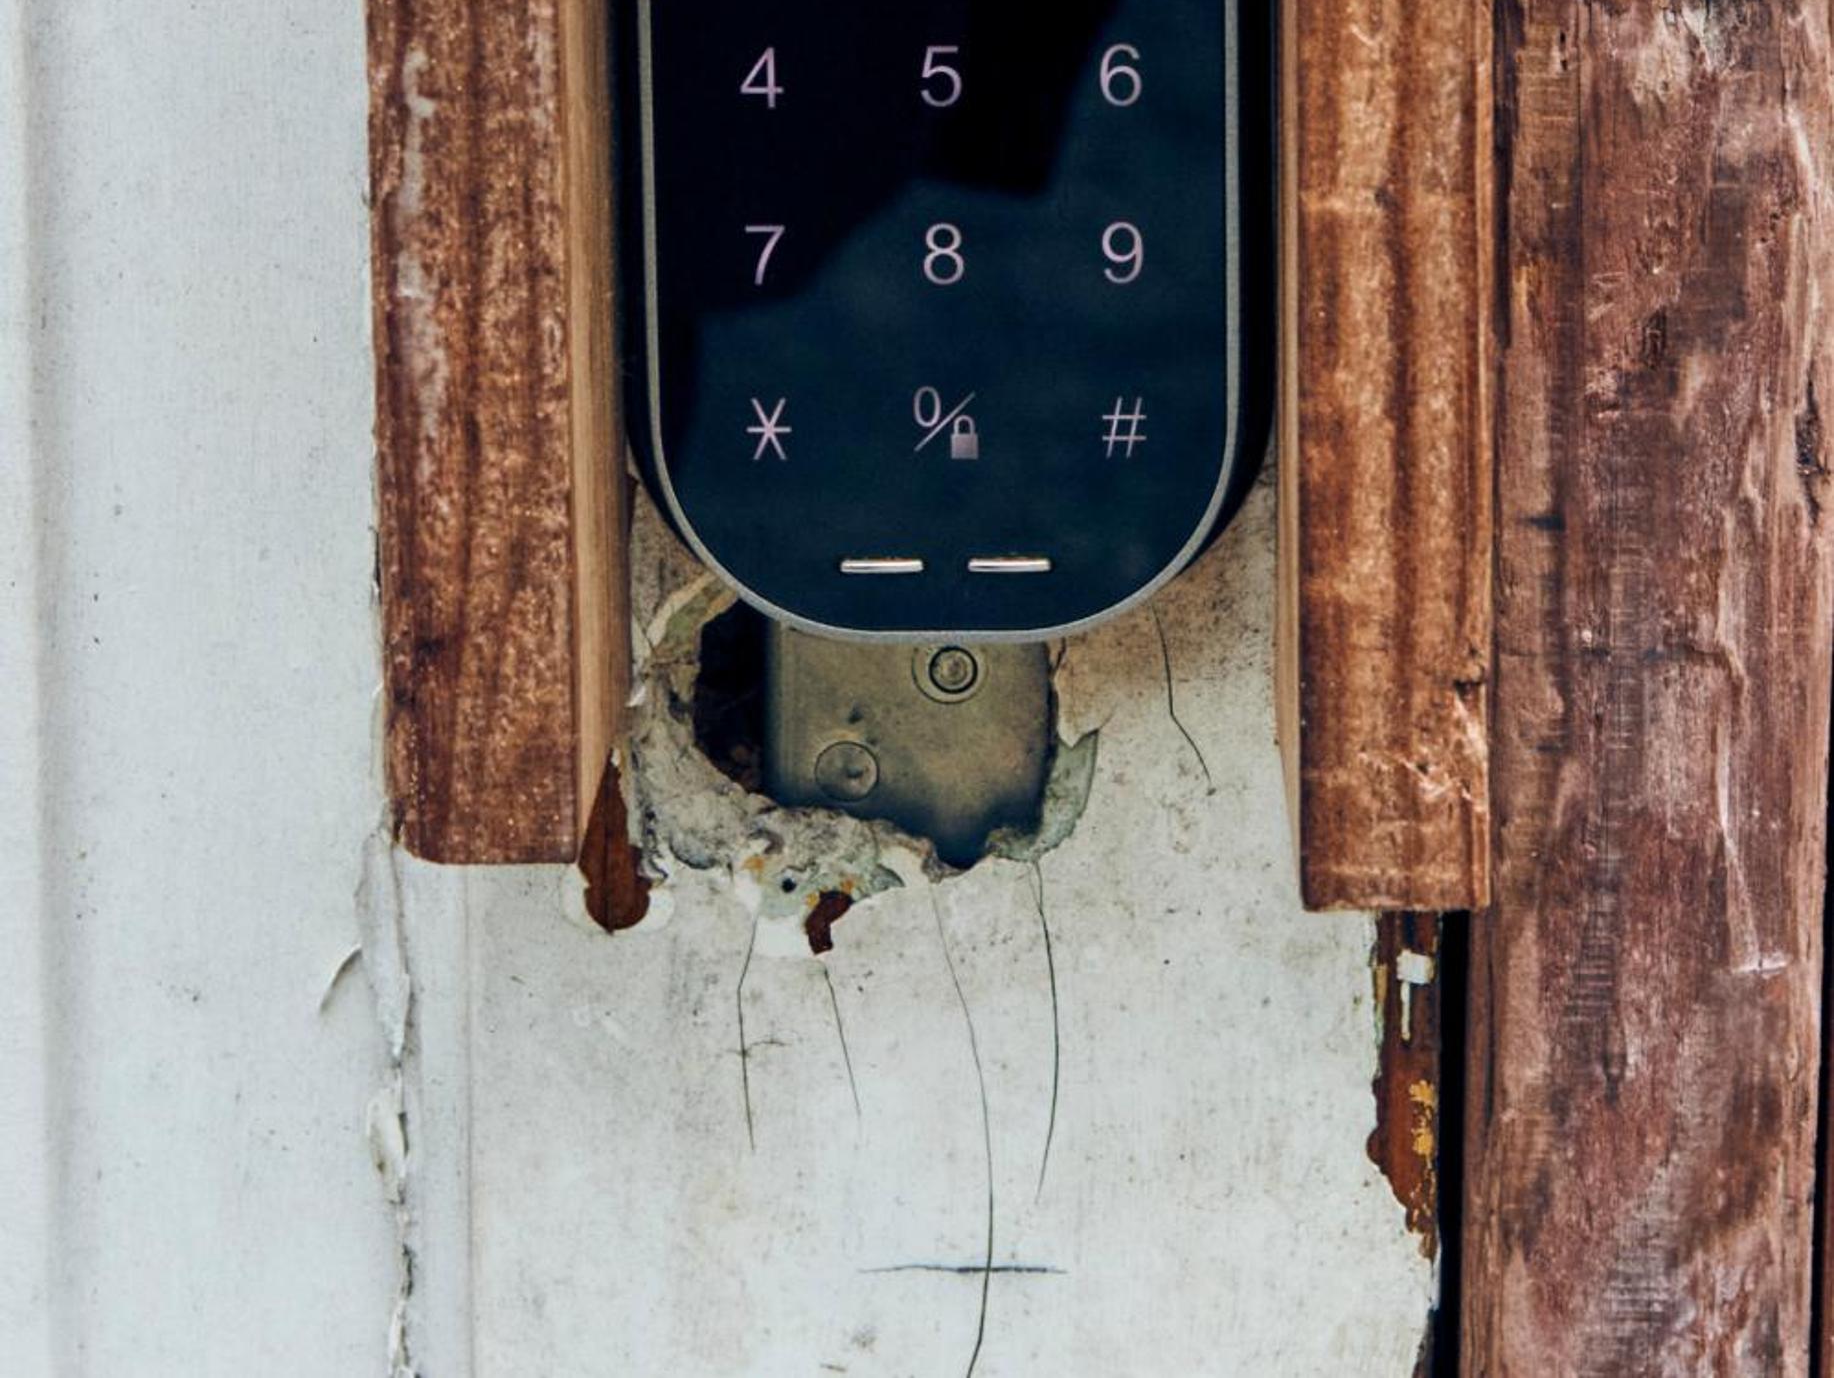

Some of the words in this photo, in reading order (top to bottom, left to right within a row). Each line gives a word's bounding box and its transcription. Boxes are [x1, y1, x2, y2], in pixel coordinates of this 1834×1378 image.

[740, 47, 784, 108] 4
[920, 46, 962, 107] 5
[1100, 44, 1143, 106] 6
[744, 225, 786, 285] 7
[922, 223, 965, 285] 8
[1101, 222, 1144, 284] 9
[1101, 397, 1147, 457] #
